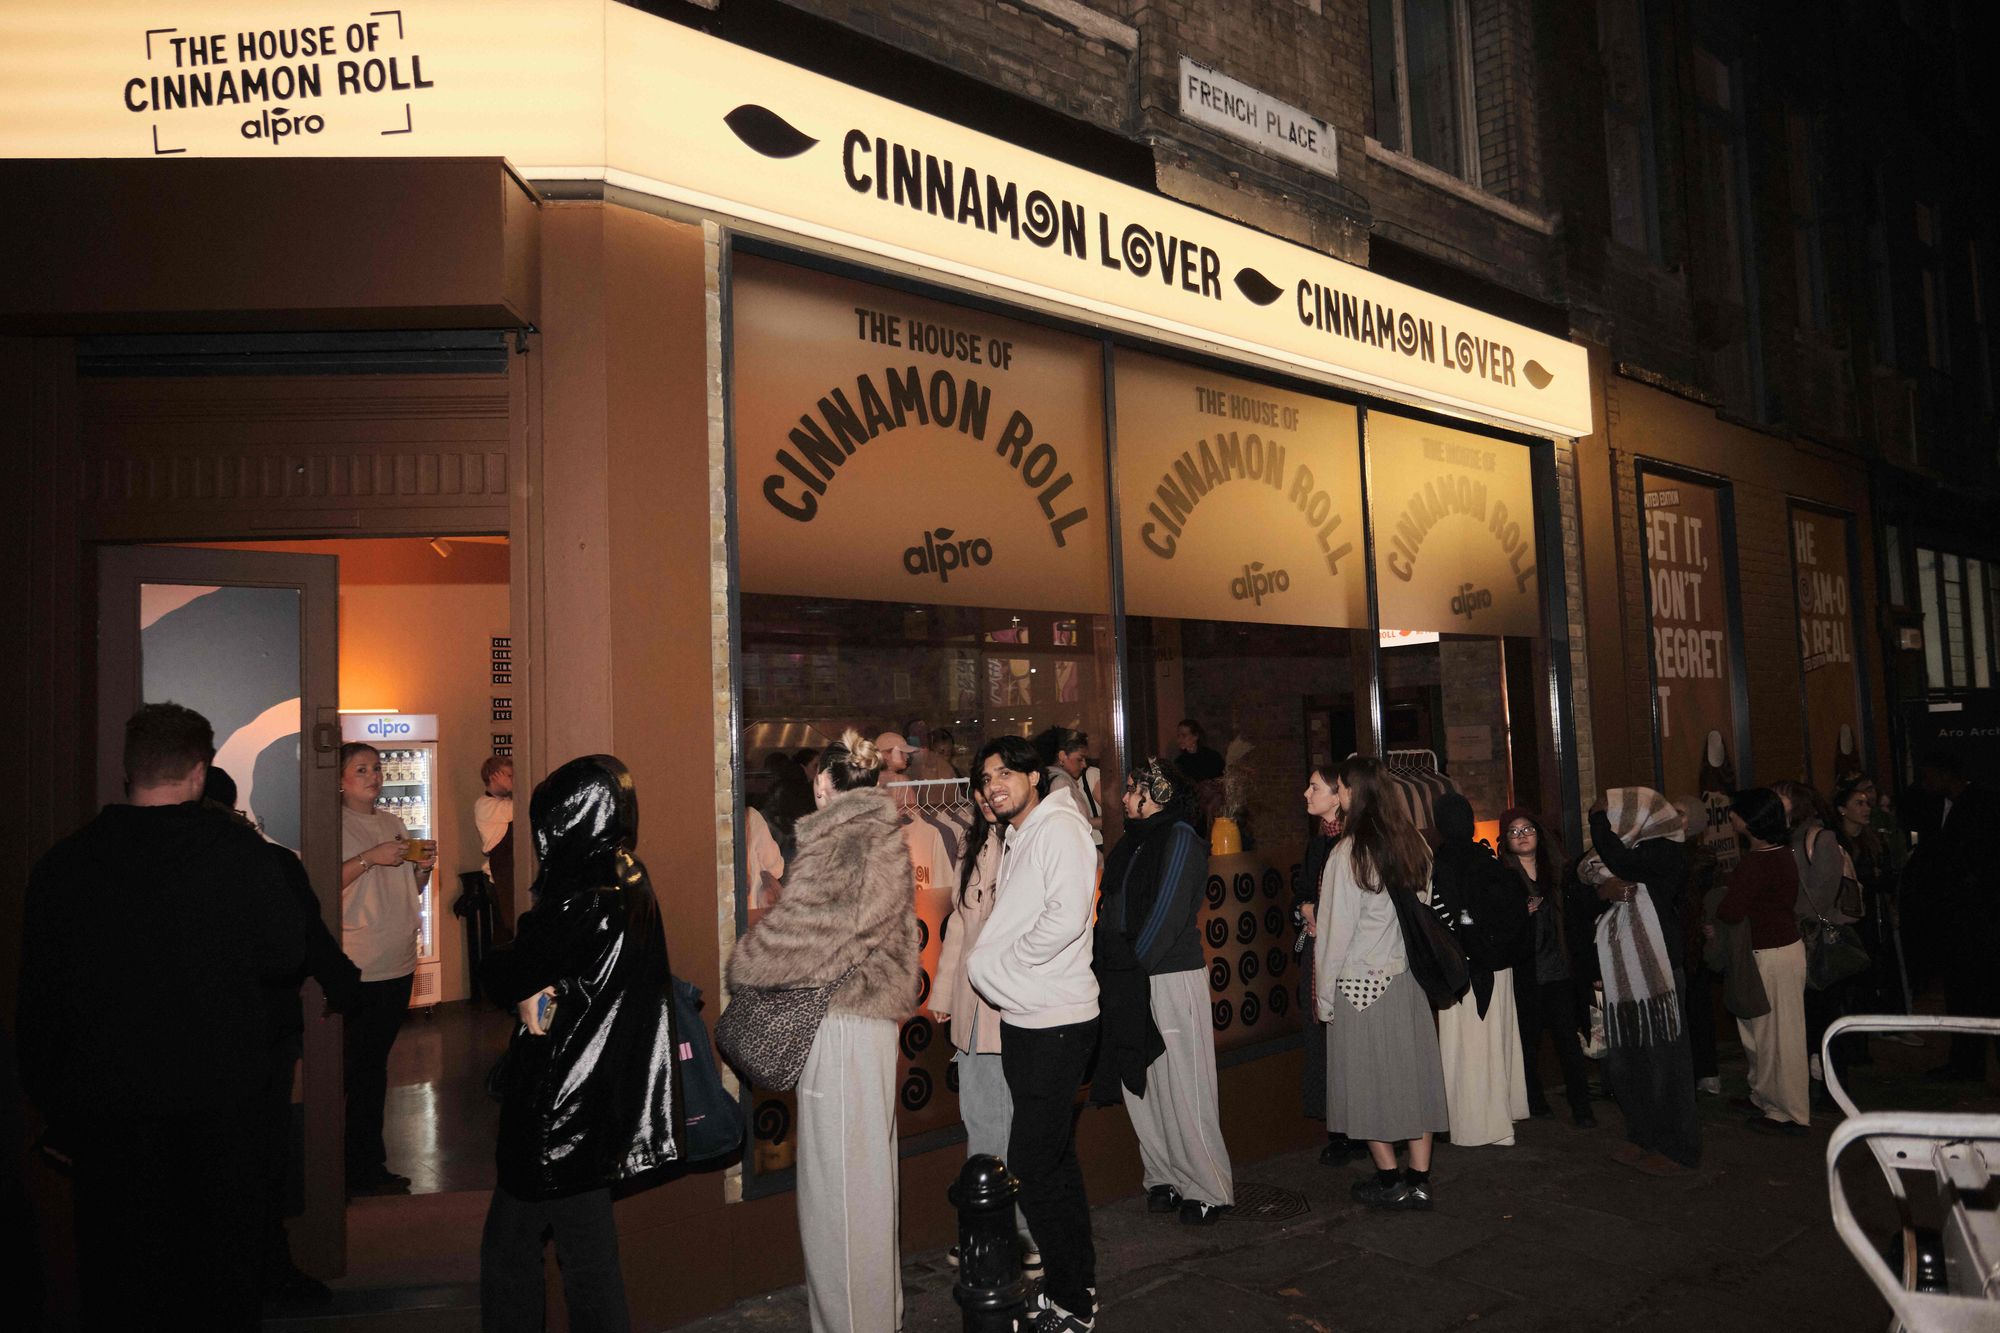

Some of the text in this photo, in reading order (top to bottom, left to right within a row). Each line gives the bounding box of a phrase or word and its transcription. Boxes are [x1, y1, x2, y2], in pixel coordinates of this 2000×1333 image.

[169, 22, 380, 68] THE HOUSE OF
[124, 55, 434, 112] CINNAMON ROLL
[240, 108, 325, 145] alpro
[1188, 75, 1318, 153] FRENCH PLACE
[842, 128, 1223, 302] CINNAMON LOVER
[854, 307, 1013, 371] THE HOUSE OF
[1297, 278, 1517, 388] CINNAMON LOVER
[1196, 386, 1299, 432] THE HOUSE OF
[762, 366, 1089, 548] CINNAMON ROLL
[1141, 431, 1353, 576] CINNAMON ROLL
[903, 528, 993, 583] alpro
[1387, 474, 1537, 594] CINNAMON ROLL
[1683, 515, 1708, 572] IT,
[1231, 561, 1290, 606] alpro
[1451, 583, 1493, 620] alpro
[1380, 630, 1397, 639] OLL
[367, 718, 411, 738] alpro
[1938, 727, 1964, 737] Aro
[1706, 798, 1732, 833] alpr
